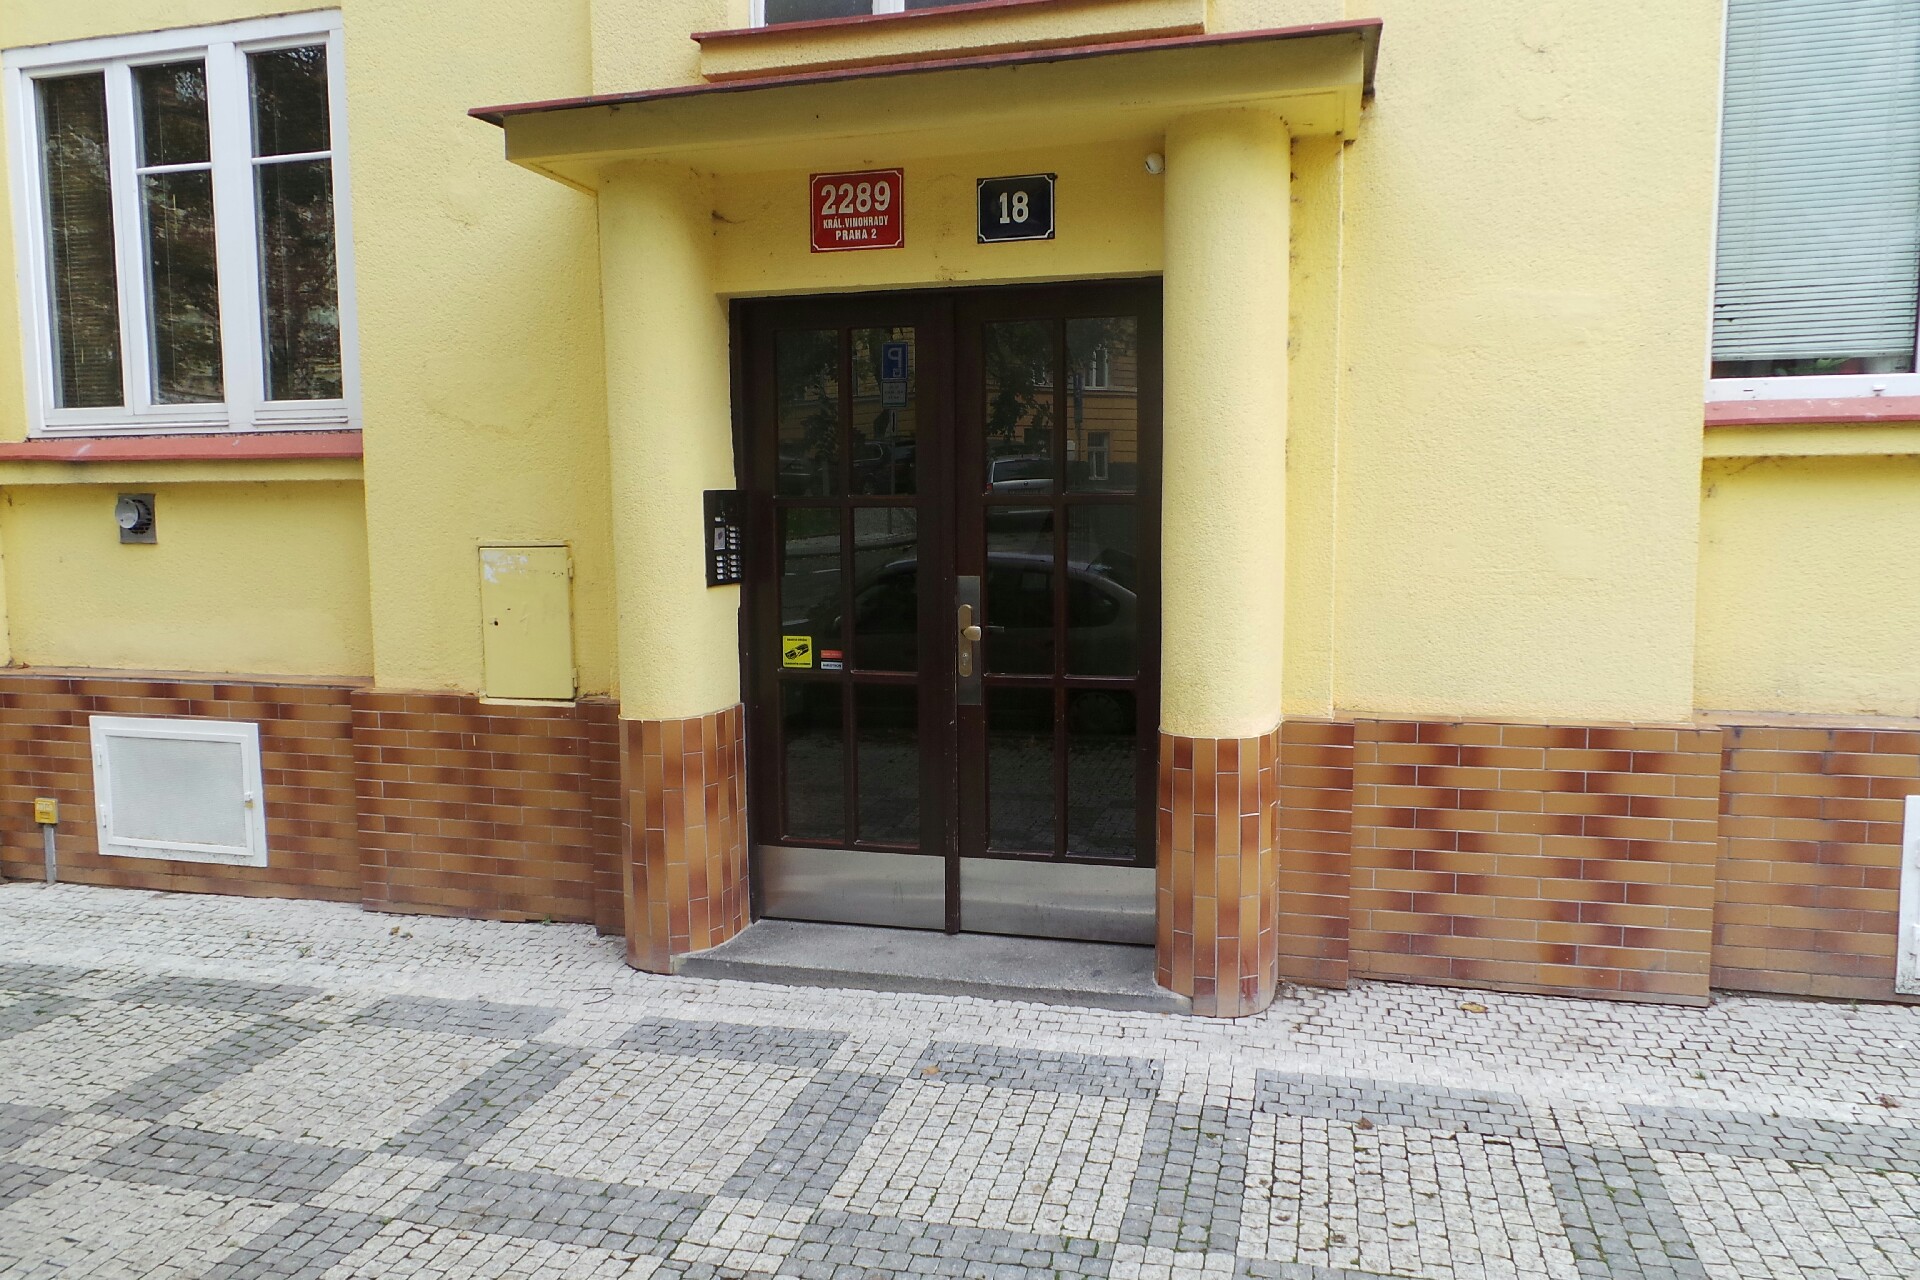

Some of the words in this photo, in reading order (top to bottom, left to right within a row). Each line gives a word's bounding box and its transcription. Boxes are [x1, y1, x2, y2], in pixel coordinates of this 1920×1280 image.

[821, 181, 890, 215] 2289
[999, 190, 1029, 224] 18
[835, 228, 868, 241] PRAHA
[871, 228, 877, 239] 2
